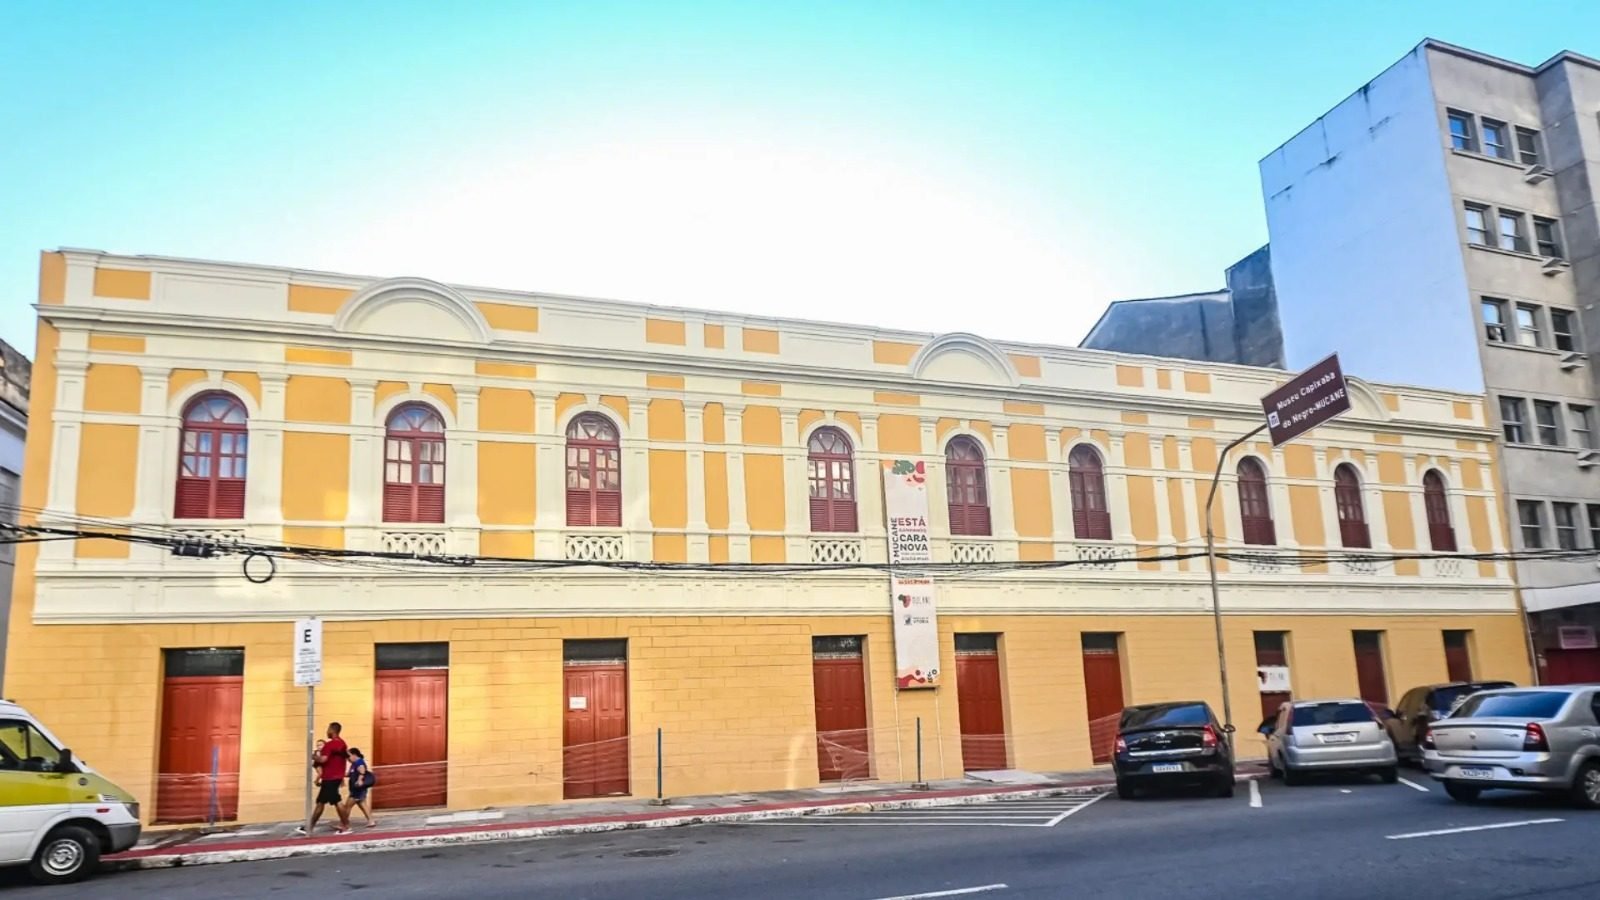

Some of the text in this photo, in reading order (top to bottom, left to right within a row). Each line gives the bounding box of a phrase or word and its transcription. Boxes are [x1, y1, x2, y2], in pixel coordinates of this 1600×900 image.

[1277, 372, 1336, 410] Museu Capixaba
[1283, 419, 1291, 428] do
[898, 516, 926, 526] ESTÁ
[891, 517, 899, 557] MUCANE
[900, 534, 928, 542] CARA
[900, 543, 928, 551] NOVA
[304, 629, 312, 643] E
